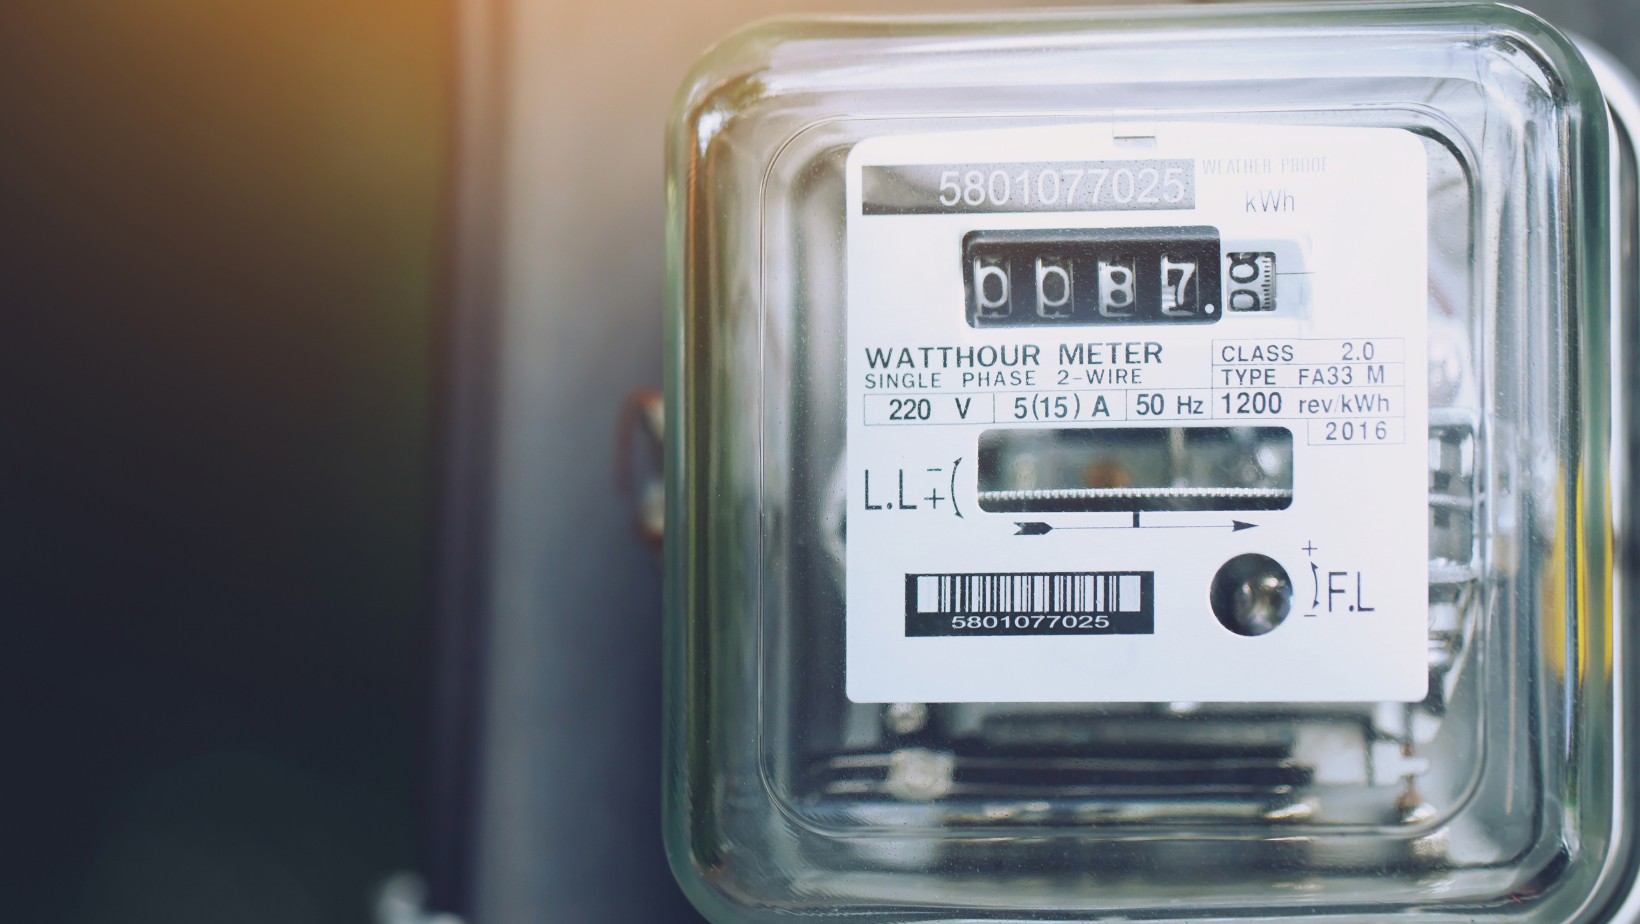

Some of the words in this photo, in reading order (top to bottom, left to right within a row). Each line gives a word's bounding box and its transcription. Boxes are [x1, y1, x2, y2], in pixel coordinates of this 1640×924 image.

[938, 166, 1185, 206] 5801077025
[1245, 189, 1295, 213] kWh
[865, 344, 1041, 370] WATTHOUR
[1059, 341, 1163, 366] METER
[1221, 345, 1294, 363] CLASS
[1341, 341, 1375, 361] 2.0
[865, 373, 942, 389] SINGLE
[962, 370, 1036, 388] PHASE
[1057, 368, 1142, 385] 2-WIRE
[1221, 368, 1276, 386] TYPE
[1298, 365, 1353, 386] FA33
[1367, 365, 1385, 384] M
[889, 398, 932, 421] 220
[955, 397, 972, 420] V
[1014, 393, 1081, 421] 5(15)
[1091, 395, 1110, 418] A
[1136, 393, 1165, 416] 50
[1177, 395, 1204, 415] Hz
[1221, 391, 1283, 415] 1200
[1299, 393, 1389, 415] rev/kWh
[1325, 420, 1387, 441] 2016
[865, 469, 917, 510] L.L
[1328, 571, 1375, 613] F.L
[951, 614, 1110, 630] 5801077025
